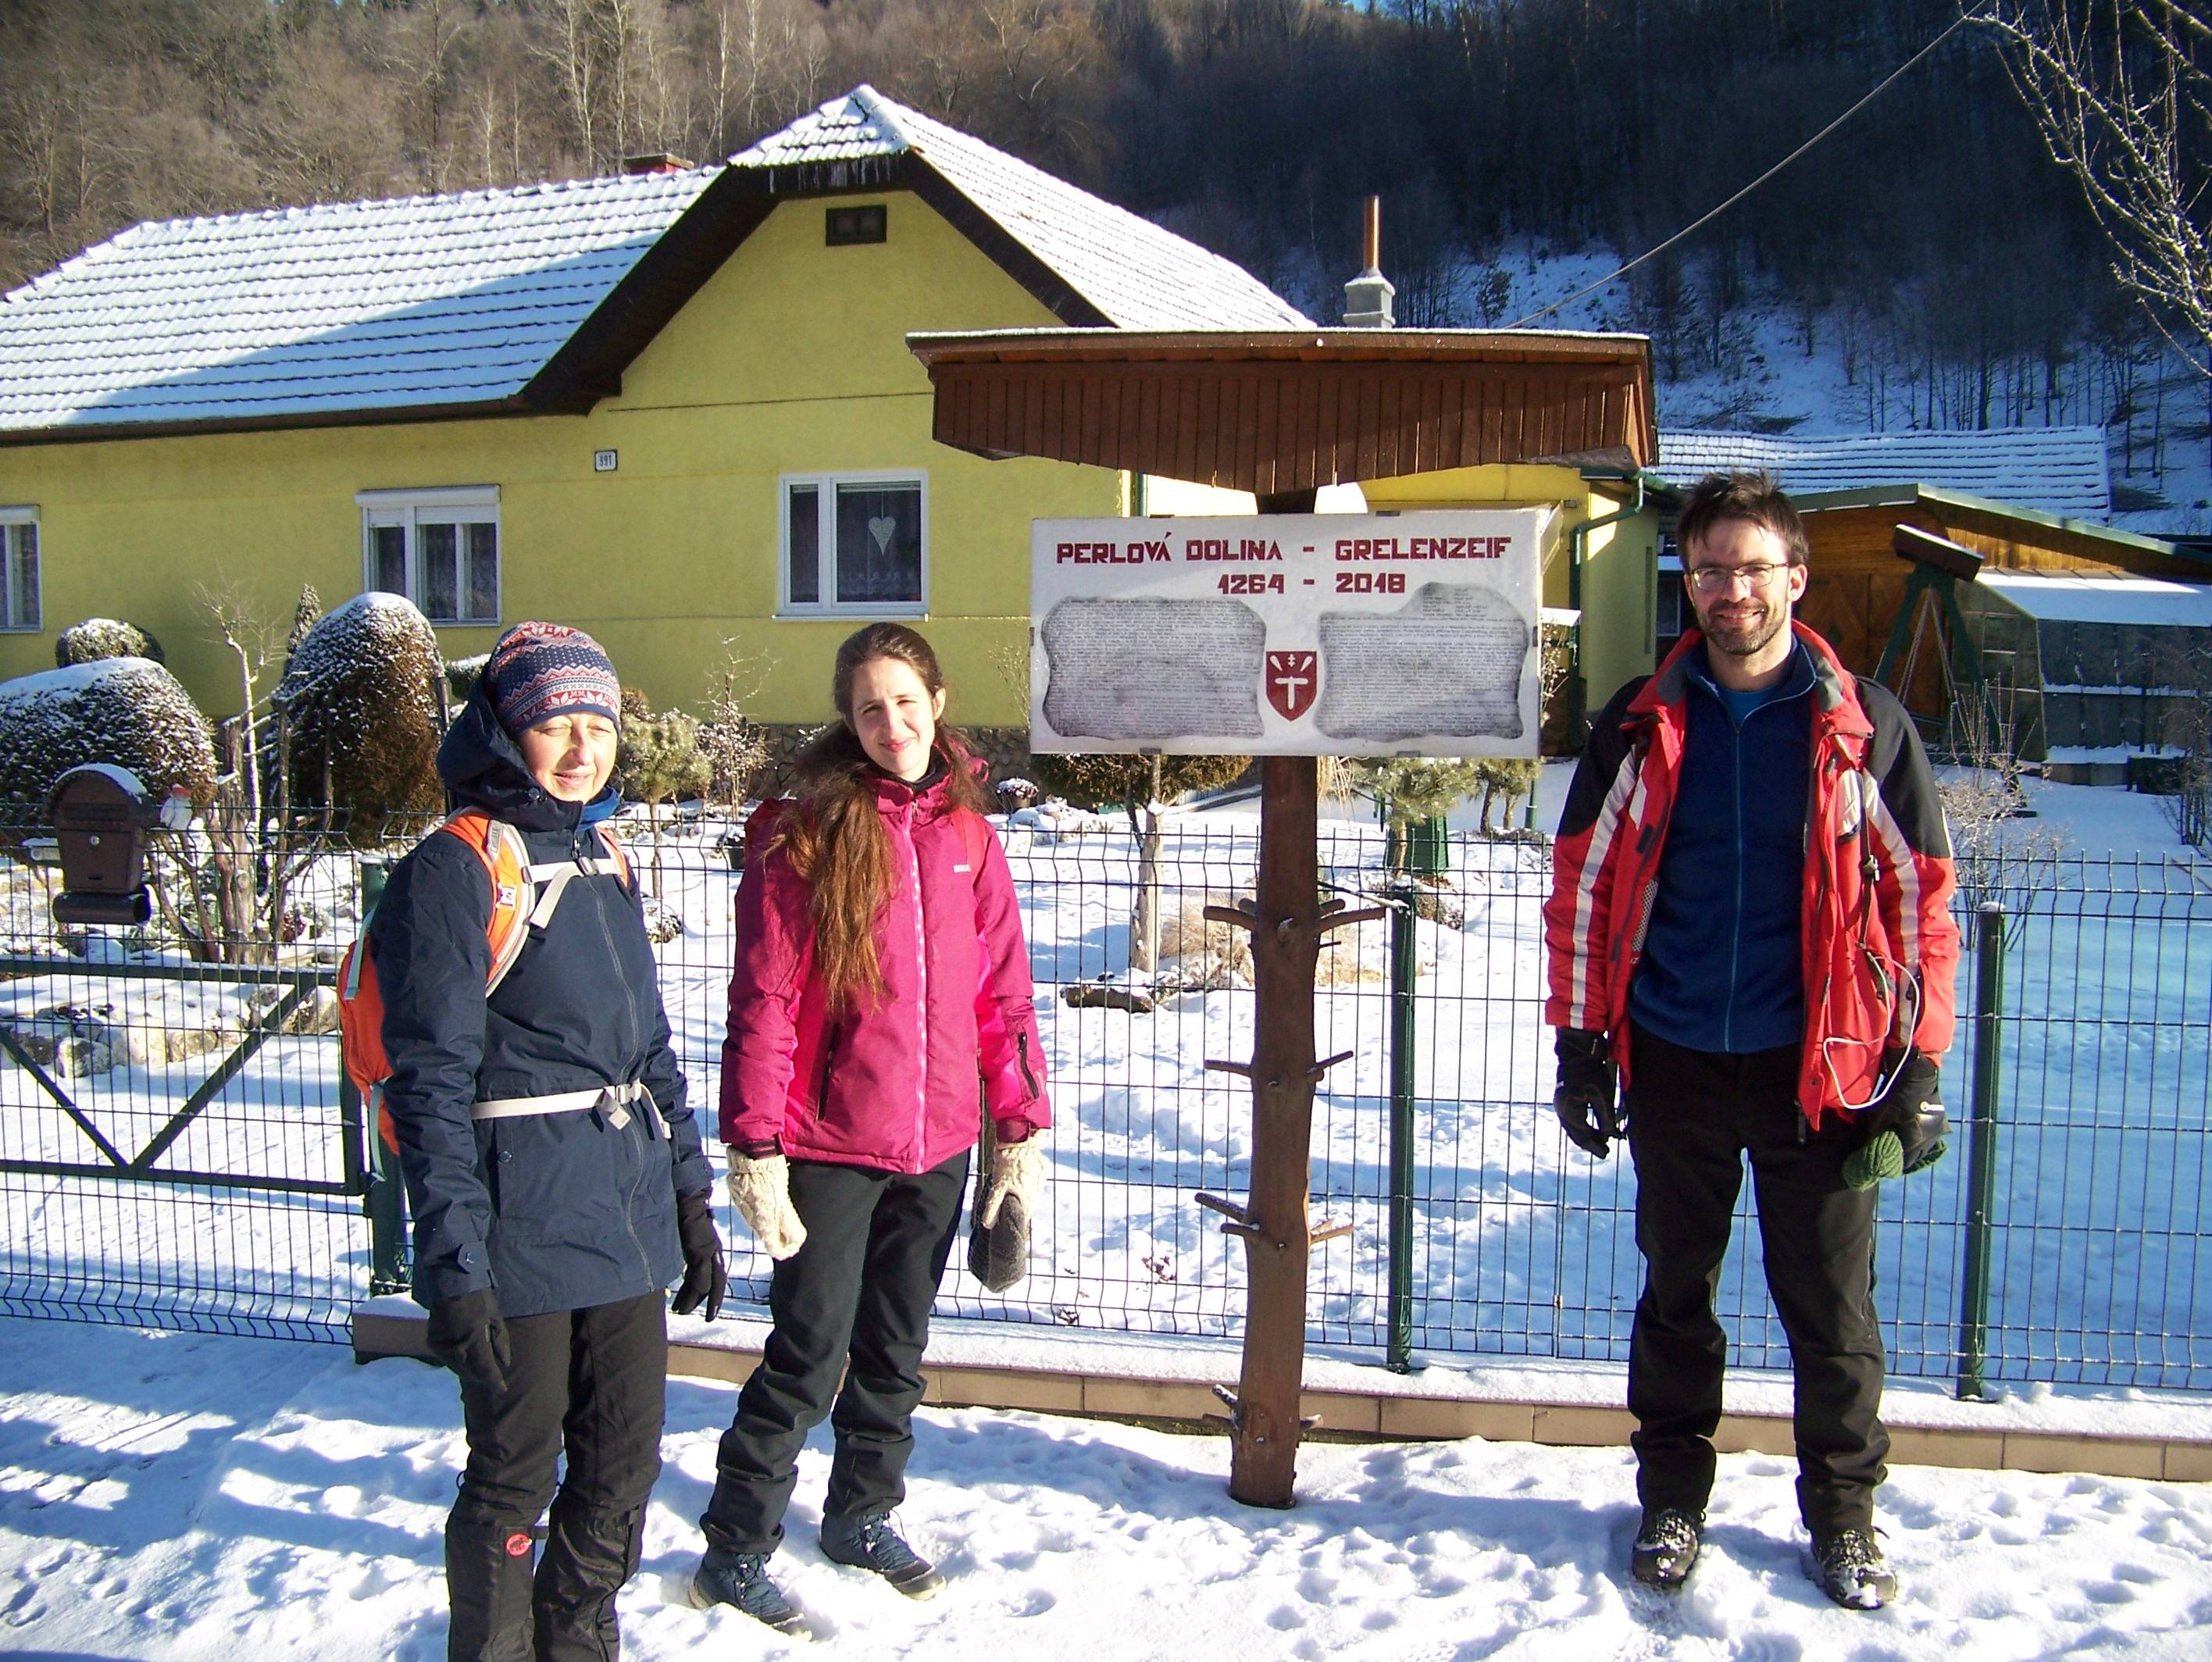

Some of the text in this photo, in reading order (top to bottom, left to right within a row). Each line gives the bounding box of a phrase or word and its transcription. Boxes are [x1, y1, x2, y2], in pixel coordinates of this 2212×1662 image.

[1056, 531, 1172, 564] PERLOVÁ
[1186, 539, 1283, 562] DOLINA
[1335, 537, 1512, 562] GRELENZEIF
[1216, 573, 1286, 594] 1264
[1335, 572, 1406, 594] 2018
